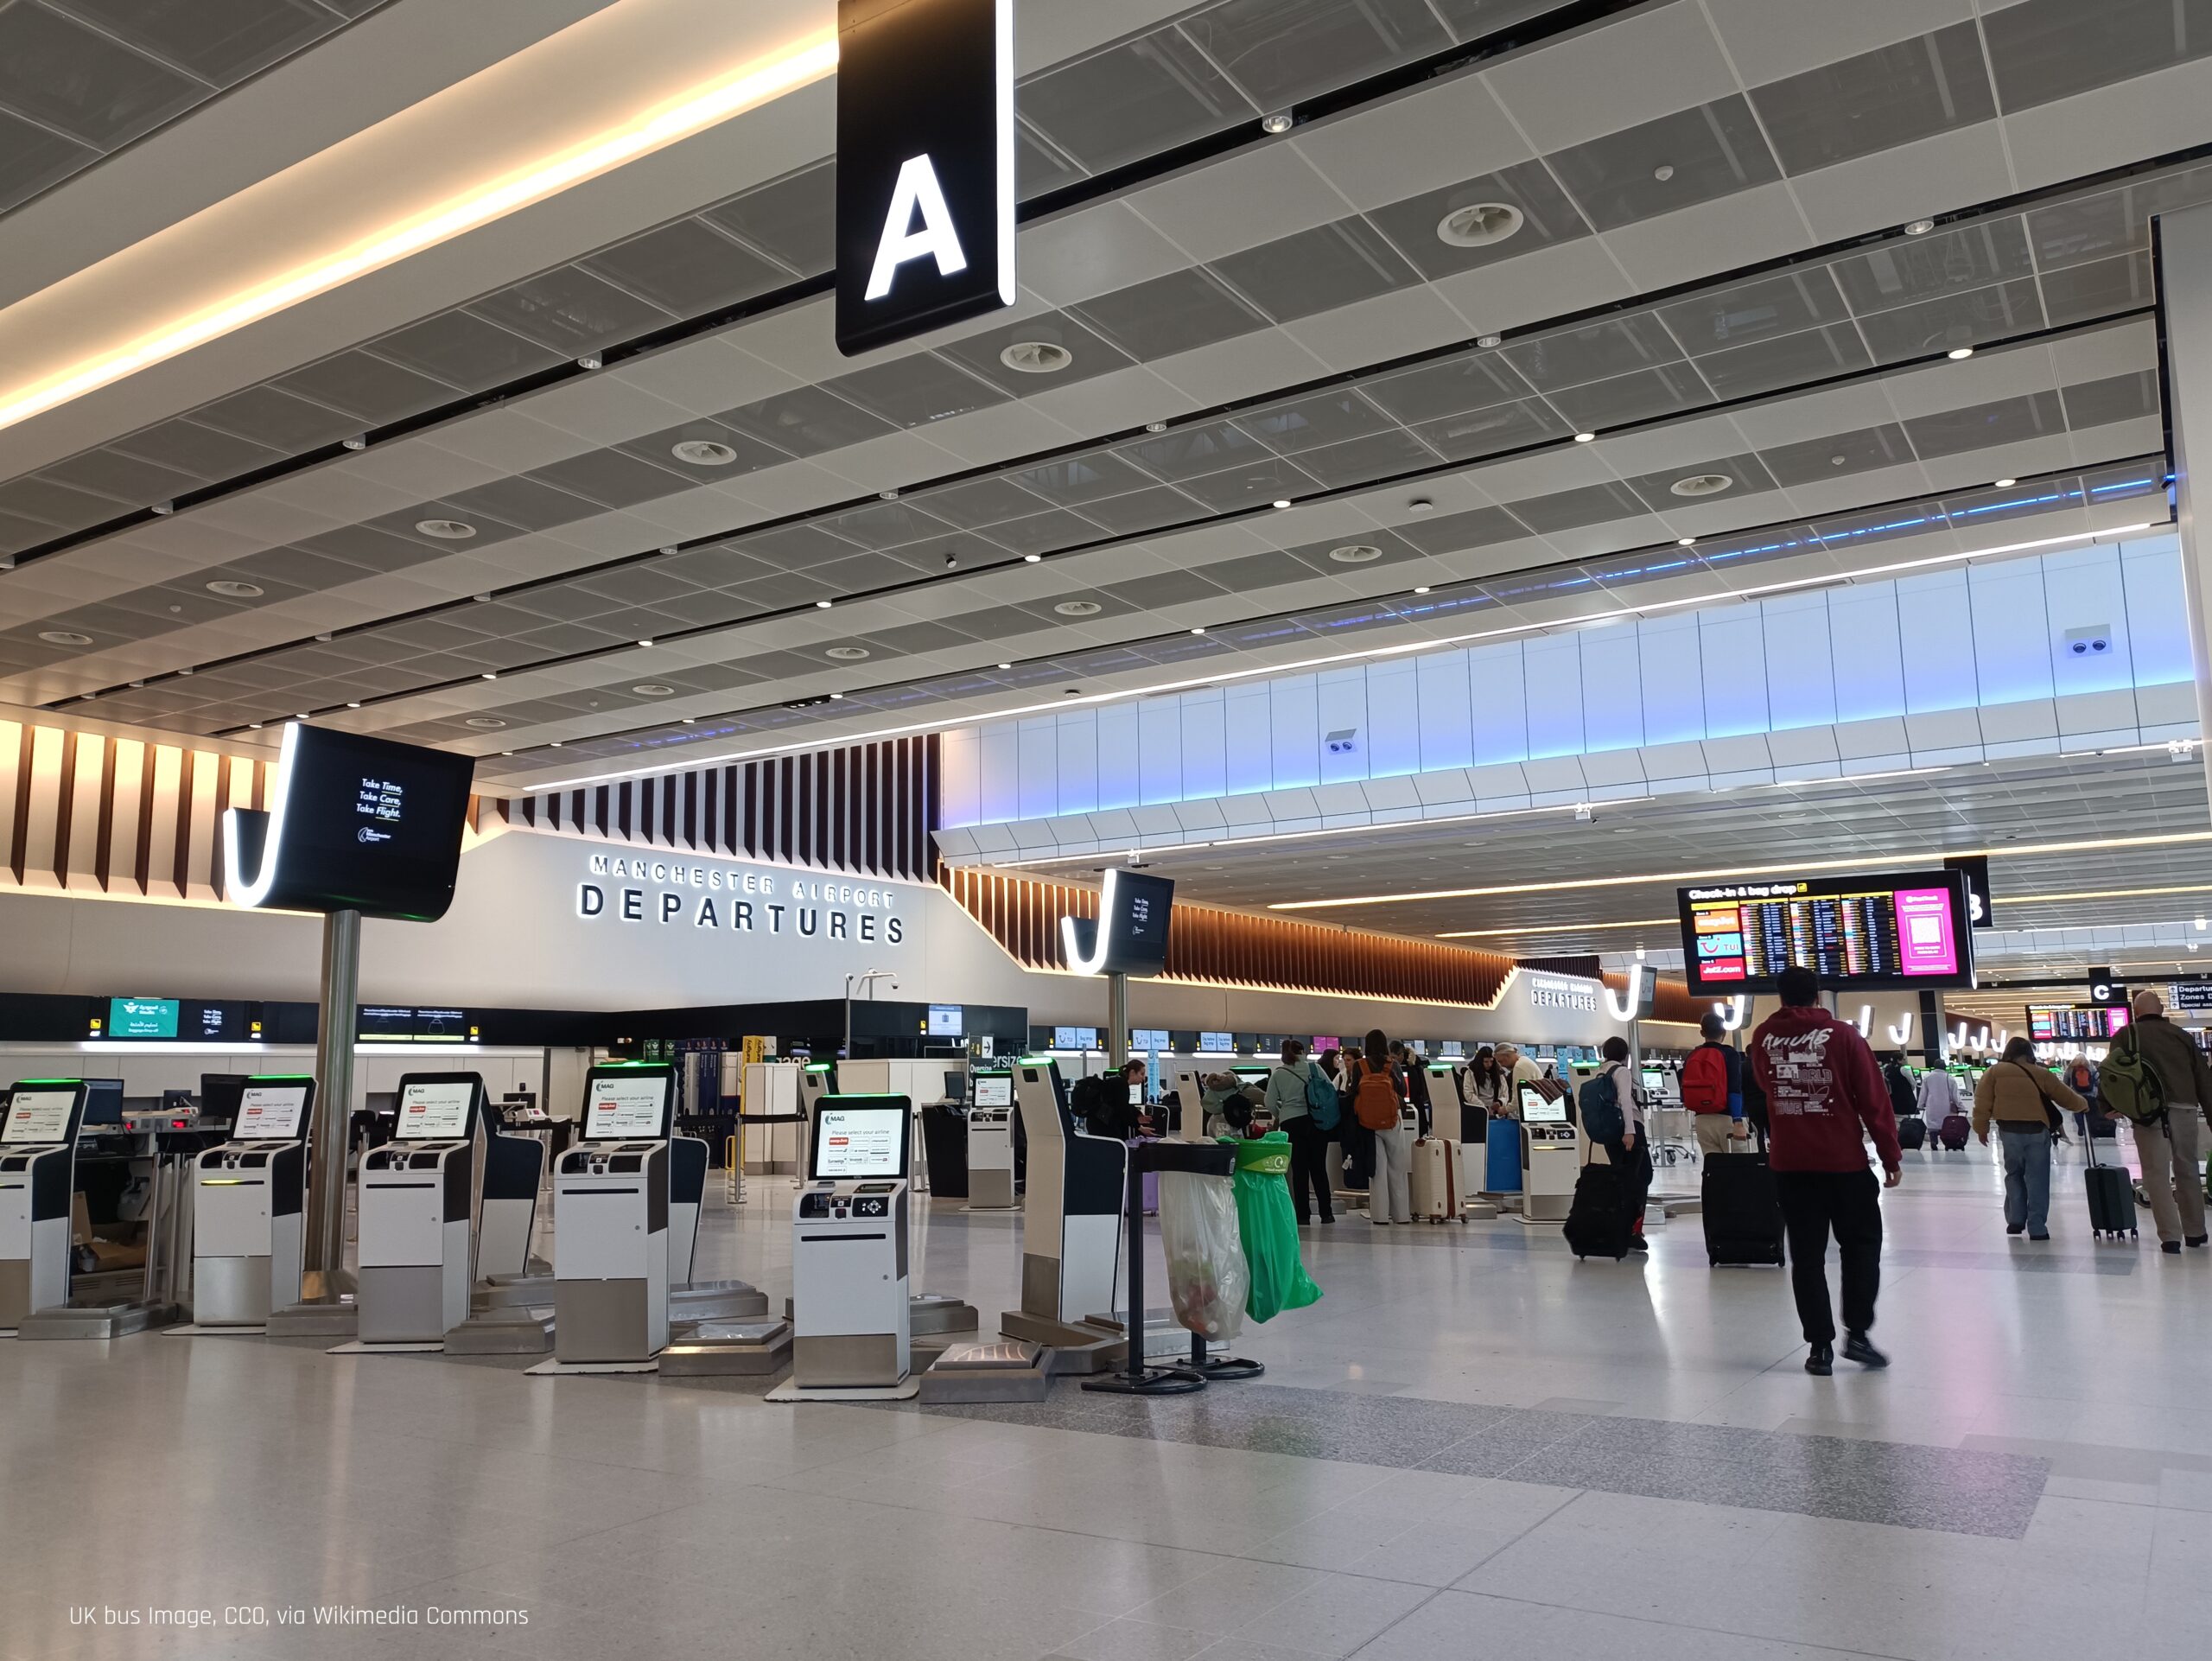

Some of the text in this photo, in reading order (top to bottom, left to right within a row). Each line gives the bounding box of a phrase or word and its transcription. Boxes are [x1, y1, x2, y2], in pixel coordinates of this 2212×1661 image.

[864, 153, 967, 301] A
[362, 778, 403, 793] Take Time,
[359, 791, 401, 805] Take Care,
[356, 803, 401, 818] Take Flight.
[593, 856, 893, 907] MANCHESTER AIRPORT
[1747, 886, 1769, 896] bag
[1770, 884, 1796, 895] drop
[581, 884, 903, 944] DEPARTURES
[1970, 894, 1983, 921] B
[2094, 985, 2109, 1000] C
[1532, 990, 1597, 1011] DEPARTURES
[969, 1064, 993, 1073] Oversize
